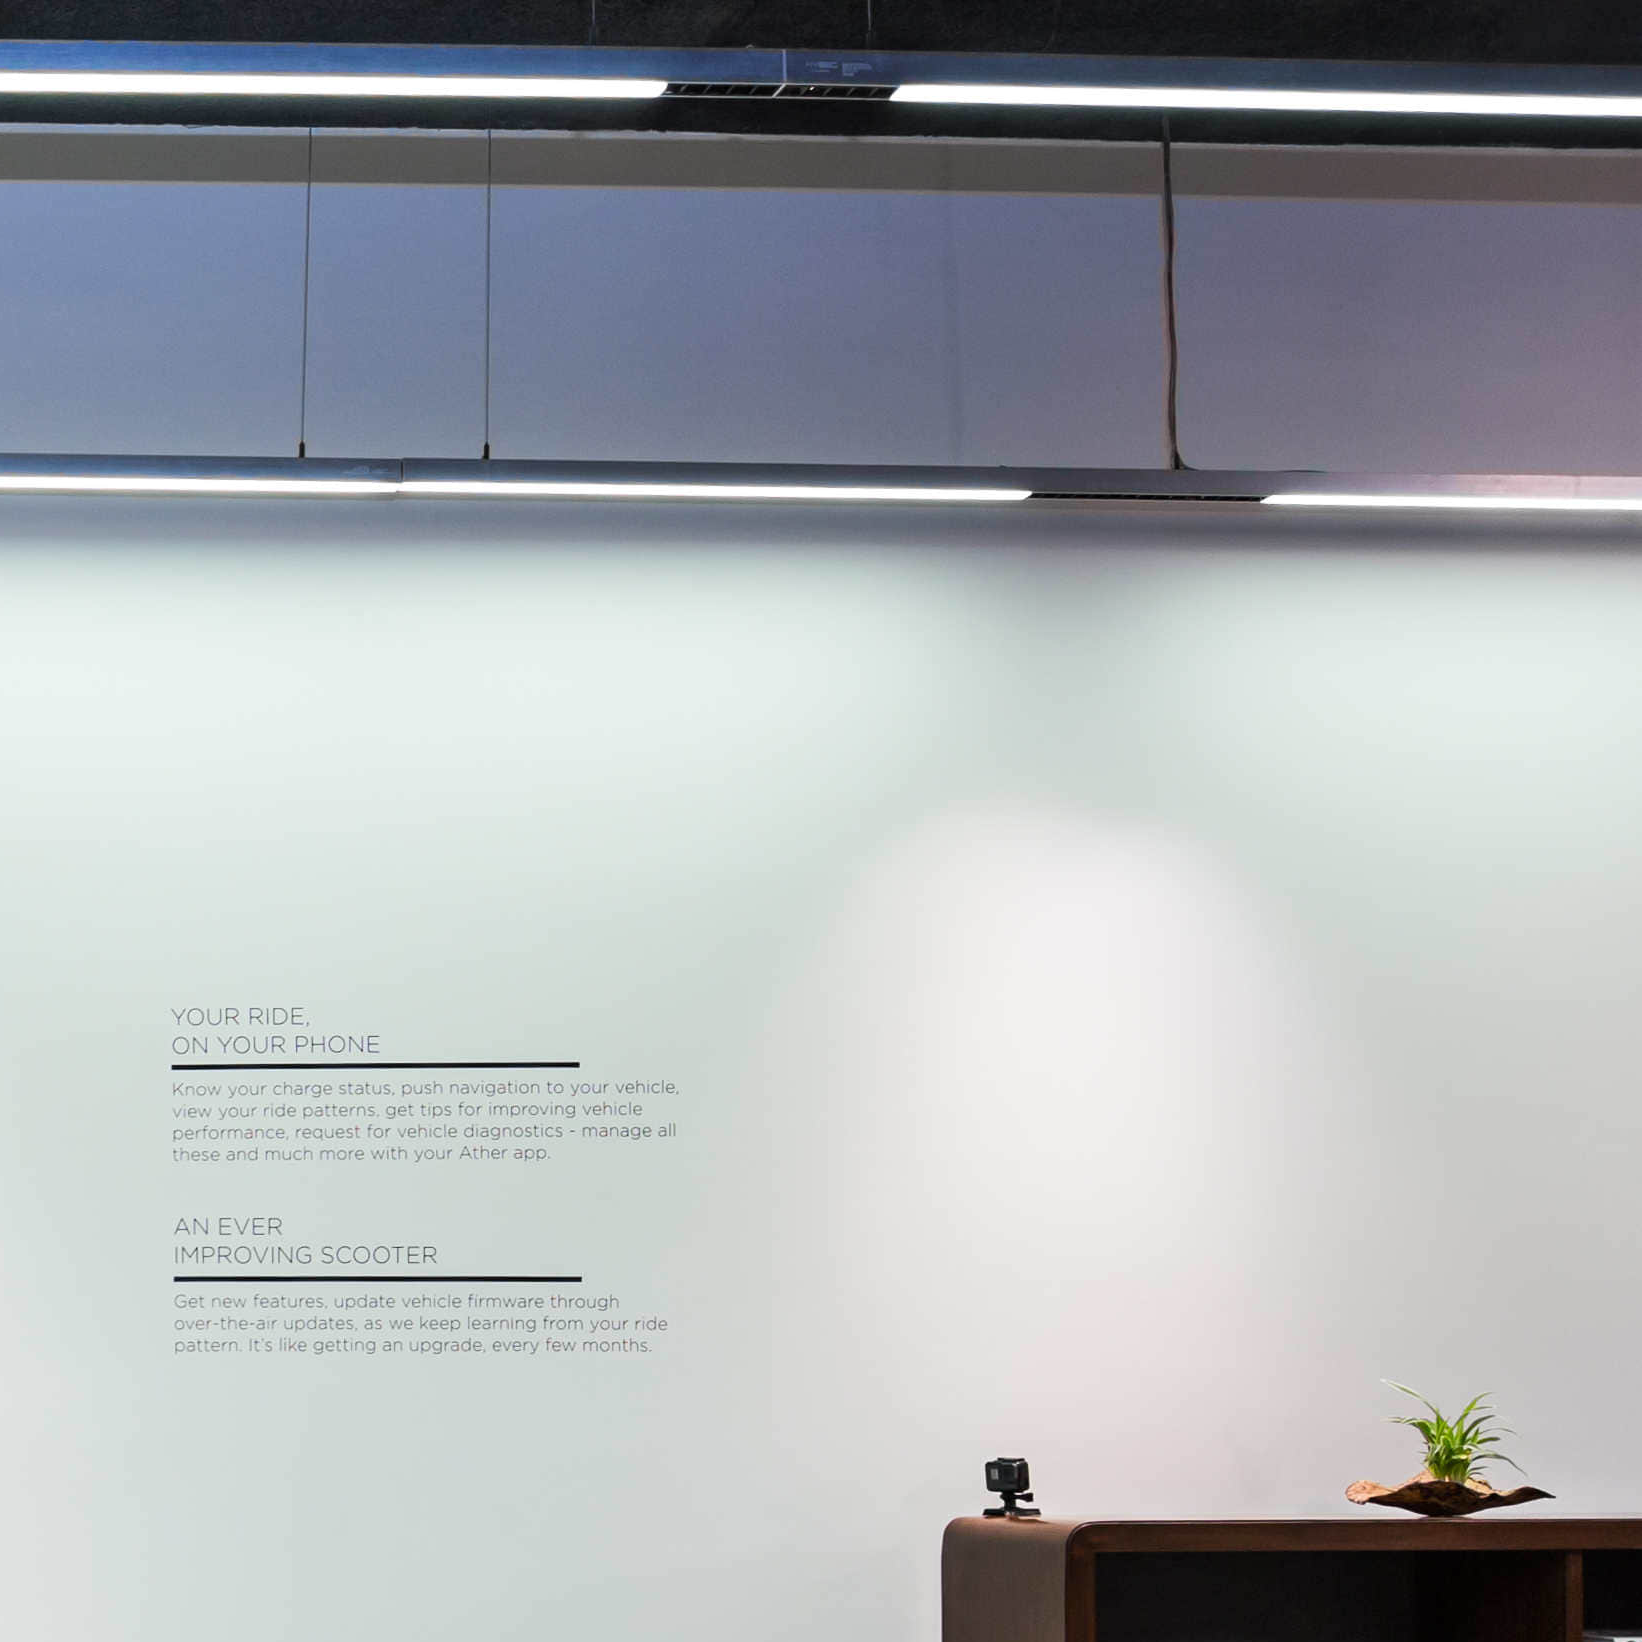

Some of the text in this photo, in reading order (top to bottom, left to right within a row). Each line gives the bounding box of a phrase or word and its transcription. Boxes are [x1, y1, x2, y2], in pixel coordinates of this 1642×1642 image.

[170, 1007, 310, 1027] YOUR RIDE,
[172, 1034, 380, 1056] ON YOUR PHONE
[172, 1079, 679, 1099] Know your charge status, push navigation to your vehicle,
[172, 1101, 643, 1121] view your ride patterns, get tips for improving vehicle
[172, 1125, 289, 1143] performance,
[295, 1125, 361, 1141] request
[367, 1123, 392, 1139] for
[397, 1124, 458, 1139] vehicle
[463, 1123, 564, 1141] diagnostics
[580, 1126, 653, 1141] manage
[657, 1122, 676, 1138] all
[172, 1145, 551, 1163] these and much more with your Ather app.
[174, 1216, 283, 1236] AN EVER
[175, 1245, 438, 1264] IMPROVING SCOOTER
[173, 1293, 620, 1312] Get new features, update vehicle firmware through
[174, 1315, 668, 1334] over-the-air updates, as we keep learning from your ride
[174, 1337, 652, 1355] pattern. It's like getting an upgrade, every few months.
